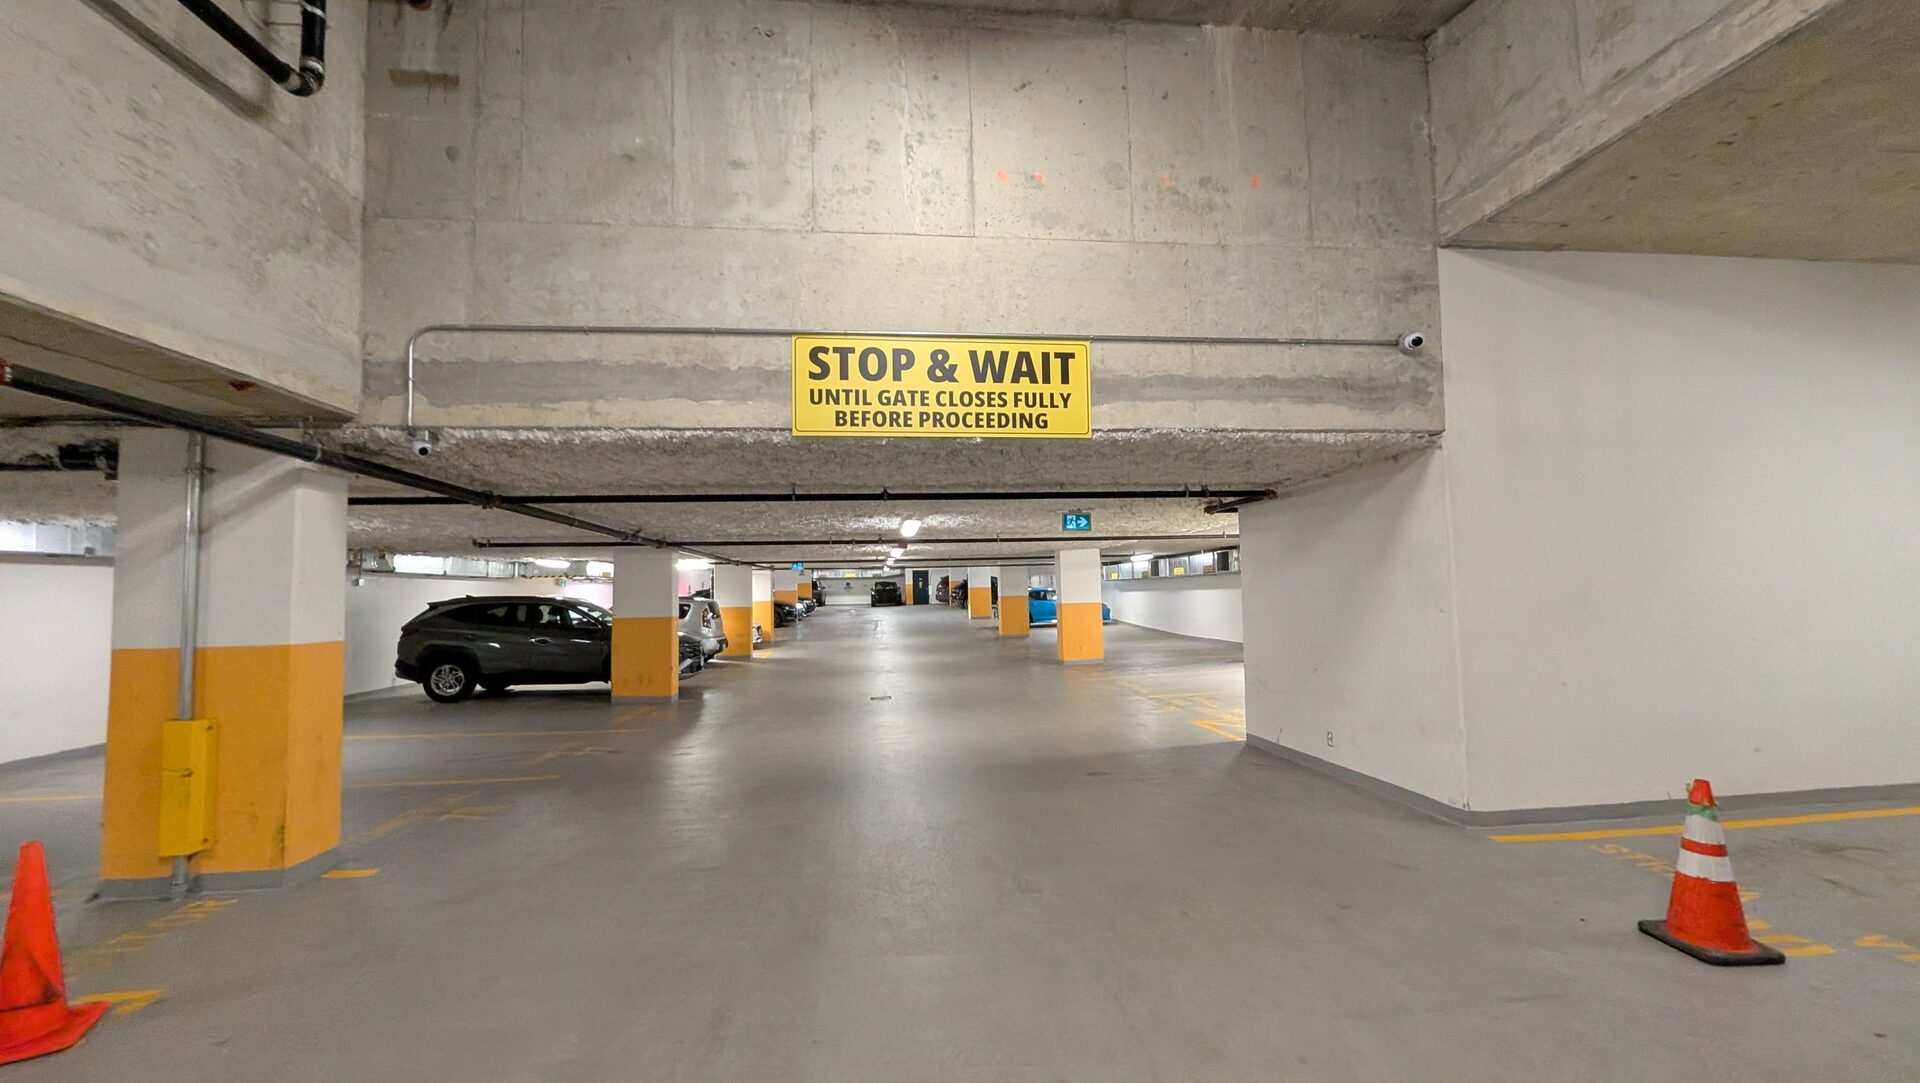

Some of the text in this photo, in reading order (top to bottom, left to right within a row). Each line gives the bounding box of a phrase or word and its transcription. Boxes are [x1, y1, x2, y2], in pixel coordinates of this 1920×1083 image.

[808, 345, 1076, 385] STOP & WAIT
[809, 388, 1072, 409] UNTIL GATE CLOSES FULLY
[835, 410, 1048, 429] BEFORE PROCEEDING
